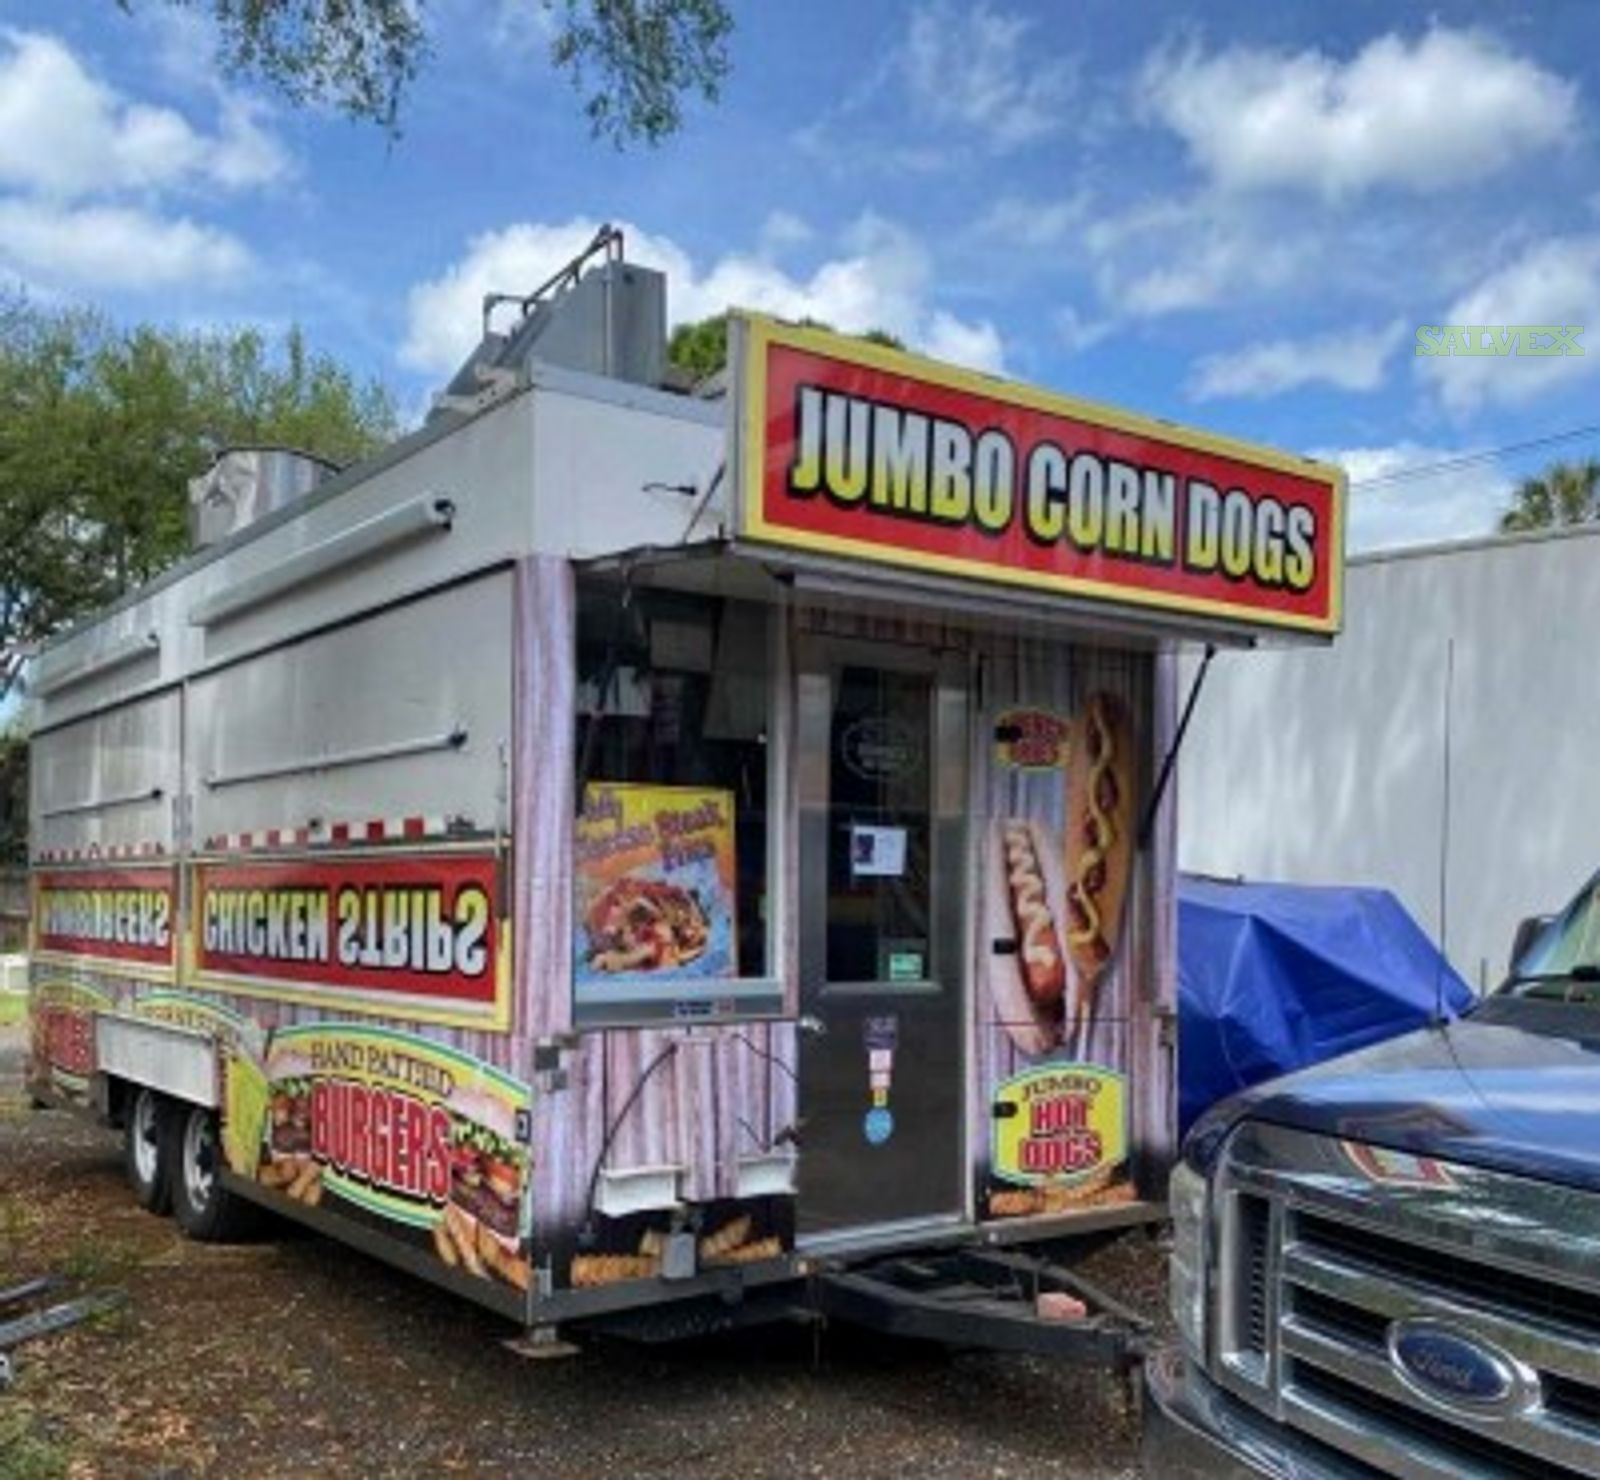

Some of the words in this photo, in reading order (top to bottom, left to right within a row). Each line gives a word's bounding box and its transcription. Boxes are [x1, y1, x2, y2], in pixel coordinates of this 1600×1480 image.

[788, 385, 1016, 534] JUMBO
[1025, 439, 1177, 567] CORN
[1184, 478, 1316, 591] DOGS
[310, 1040, 365, 1070] HAND
[1021, 1074, 1102, 1101] JUMBO
[1030, 1094, 1090, 1137] HOT
[311, 1078, 449, 1205] BURGERS
[1018, 1133, 1103, 1174] DOGS
